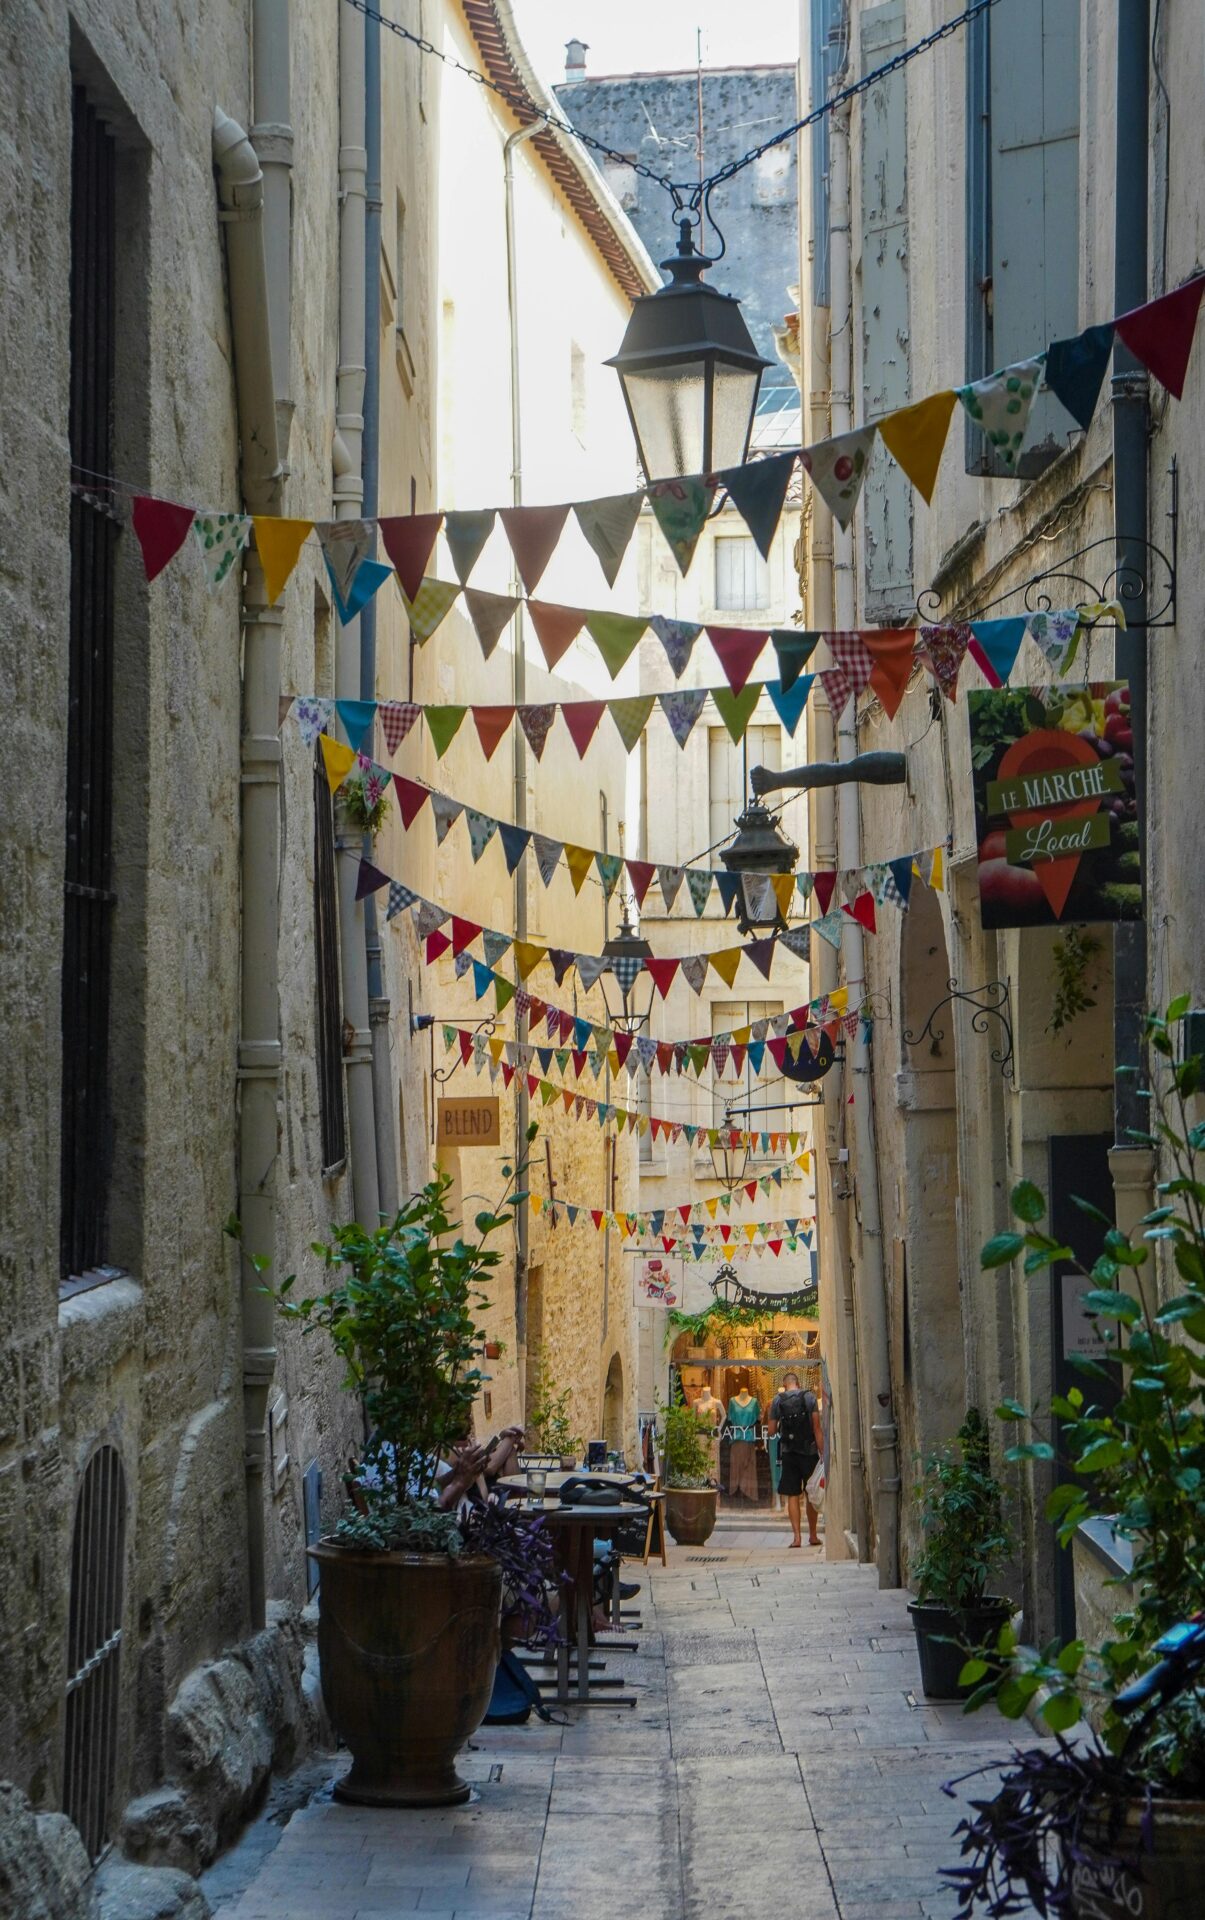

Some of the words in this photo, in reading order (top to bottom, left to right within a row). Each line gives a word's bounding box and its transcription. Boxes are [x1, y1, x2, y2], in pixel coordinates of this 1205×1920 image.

[1001, 791, 1021, 810] LE
[1023, 762, 1111, 808] MARCHÉ
[1020, 819, 1092, 863] Local
[445, 1108, 492, 1135] BLEND
[711, 1425, 749, 1440] CATY
